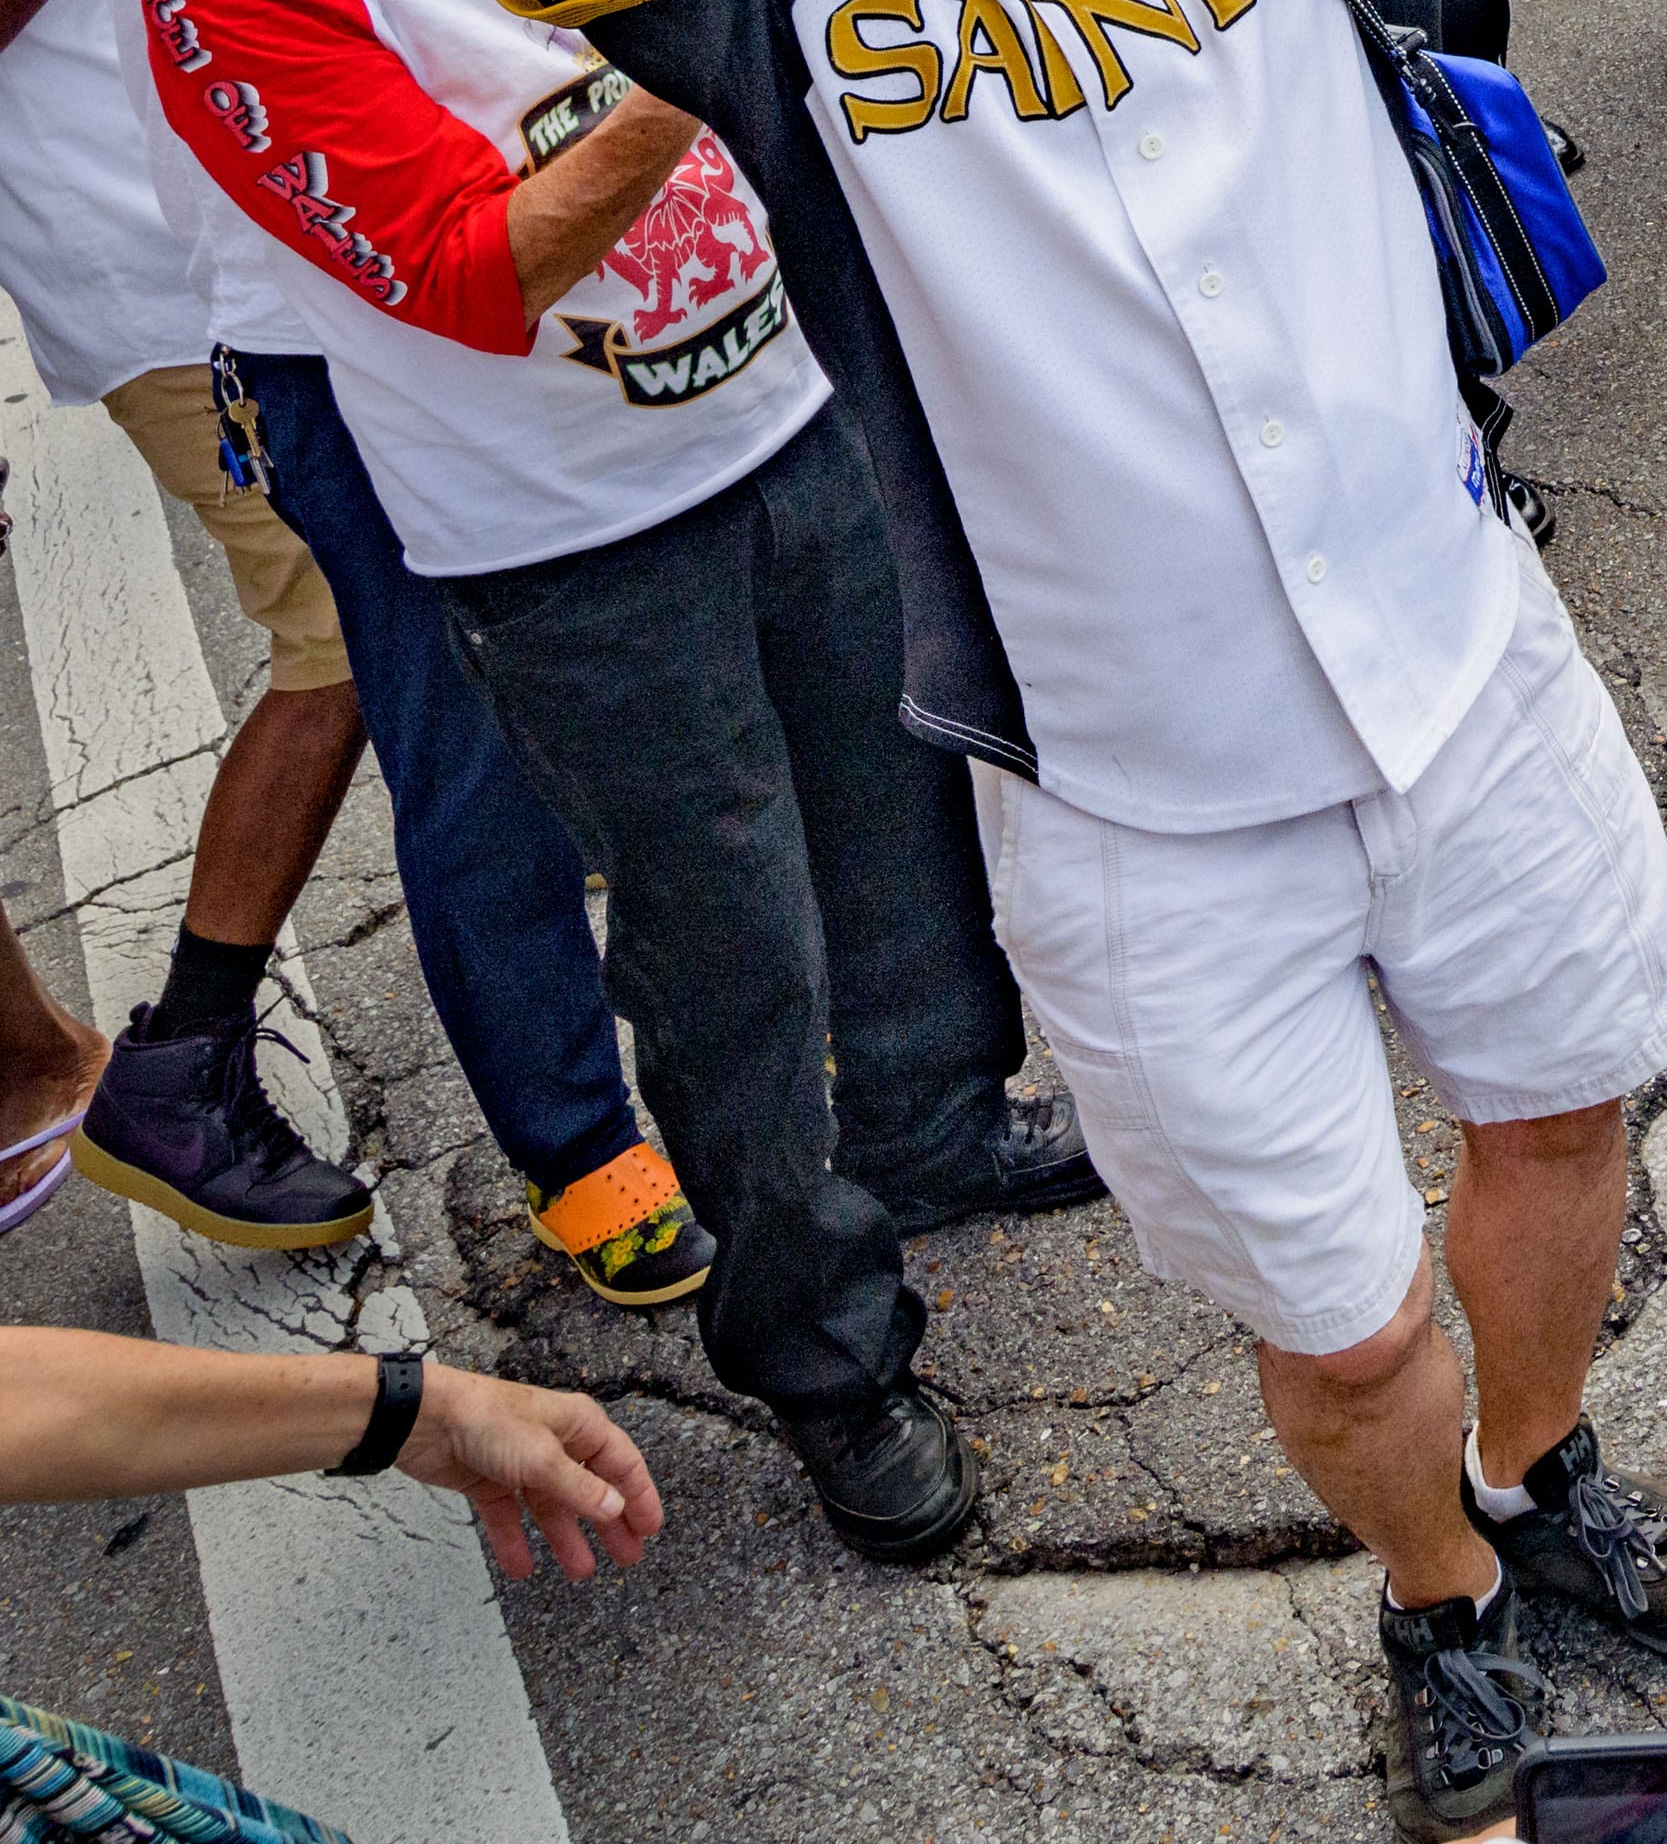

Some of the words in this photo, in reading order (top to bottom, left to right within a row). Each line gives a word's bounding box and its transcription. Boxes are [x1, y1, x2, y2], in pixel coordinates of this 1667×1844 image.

[528, 96, 581, 156] THE
[203, 80, 272, 154] OF
[257, 150, 409, 307] WALES
[1558, 1427, 1593, 1477] HH
